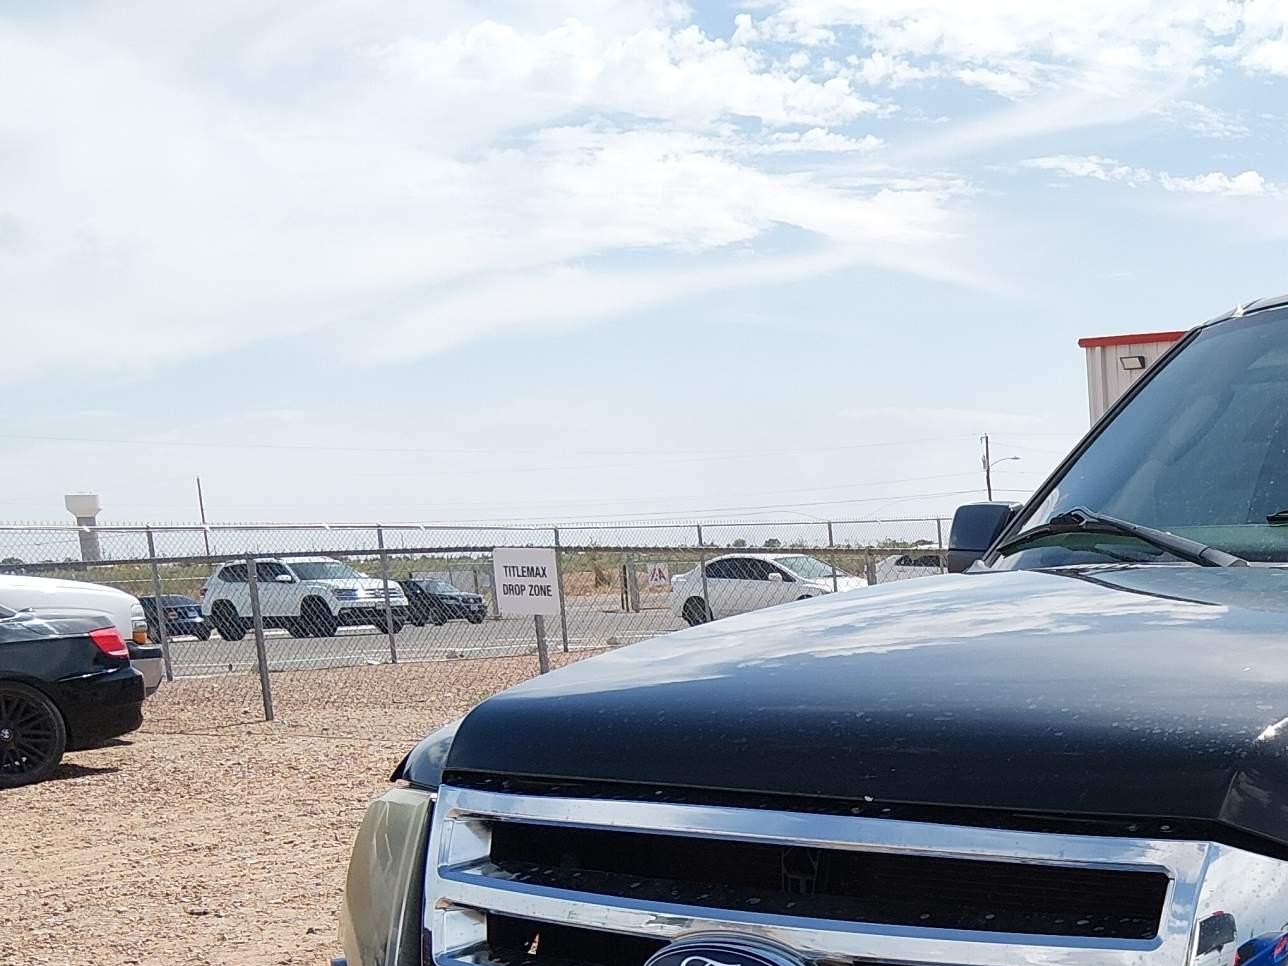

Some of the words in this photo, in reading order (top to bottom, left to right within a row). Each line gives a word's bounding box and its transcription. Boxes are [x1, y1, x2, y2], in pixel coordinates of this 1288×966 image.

[503, 565, 547, 578] TITLEMAX
[502, 583, 526, 596] DROP
[528, 584, 552, 597] ZONE
